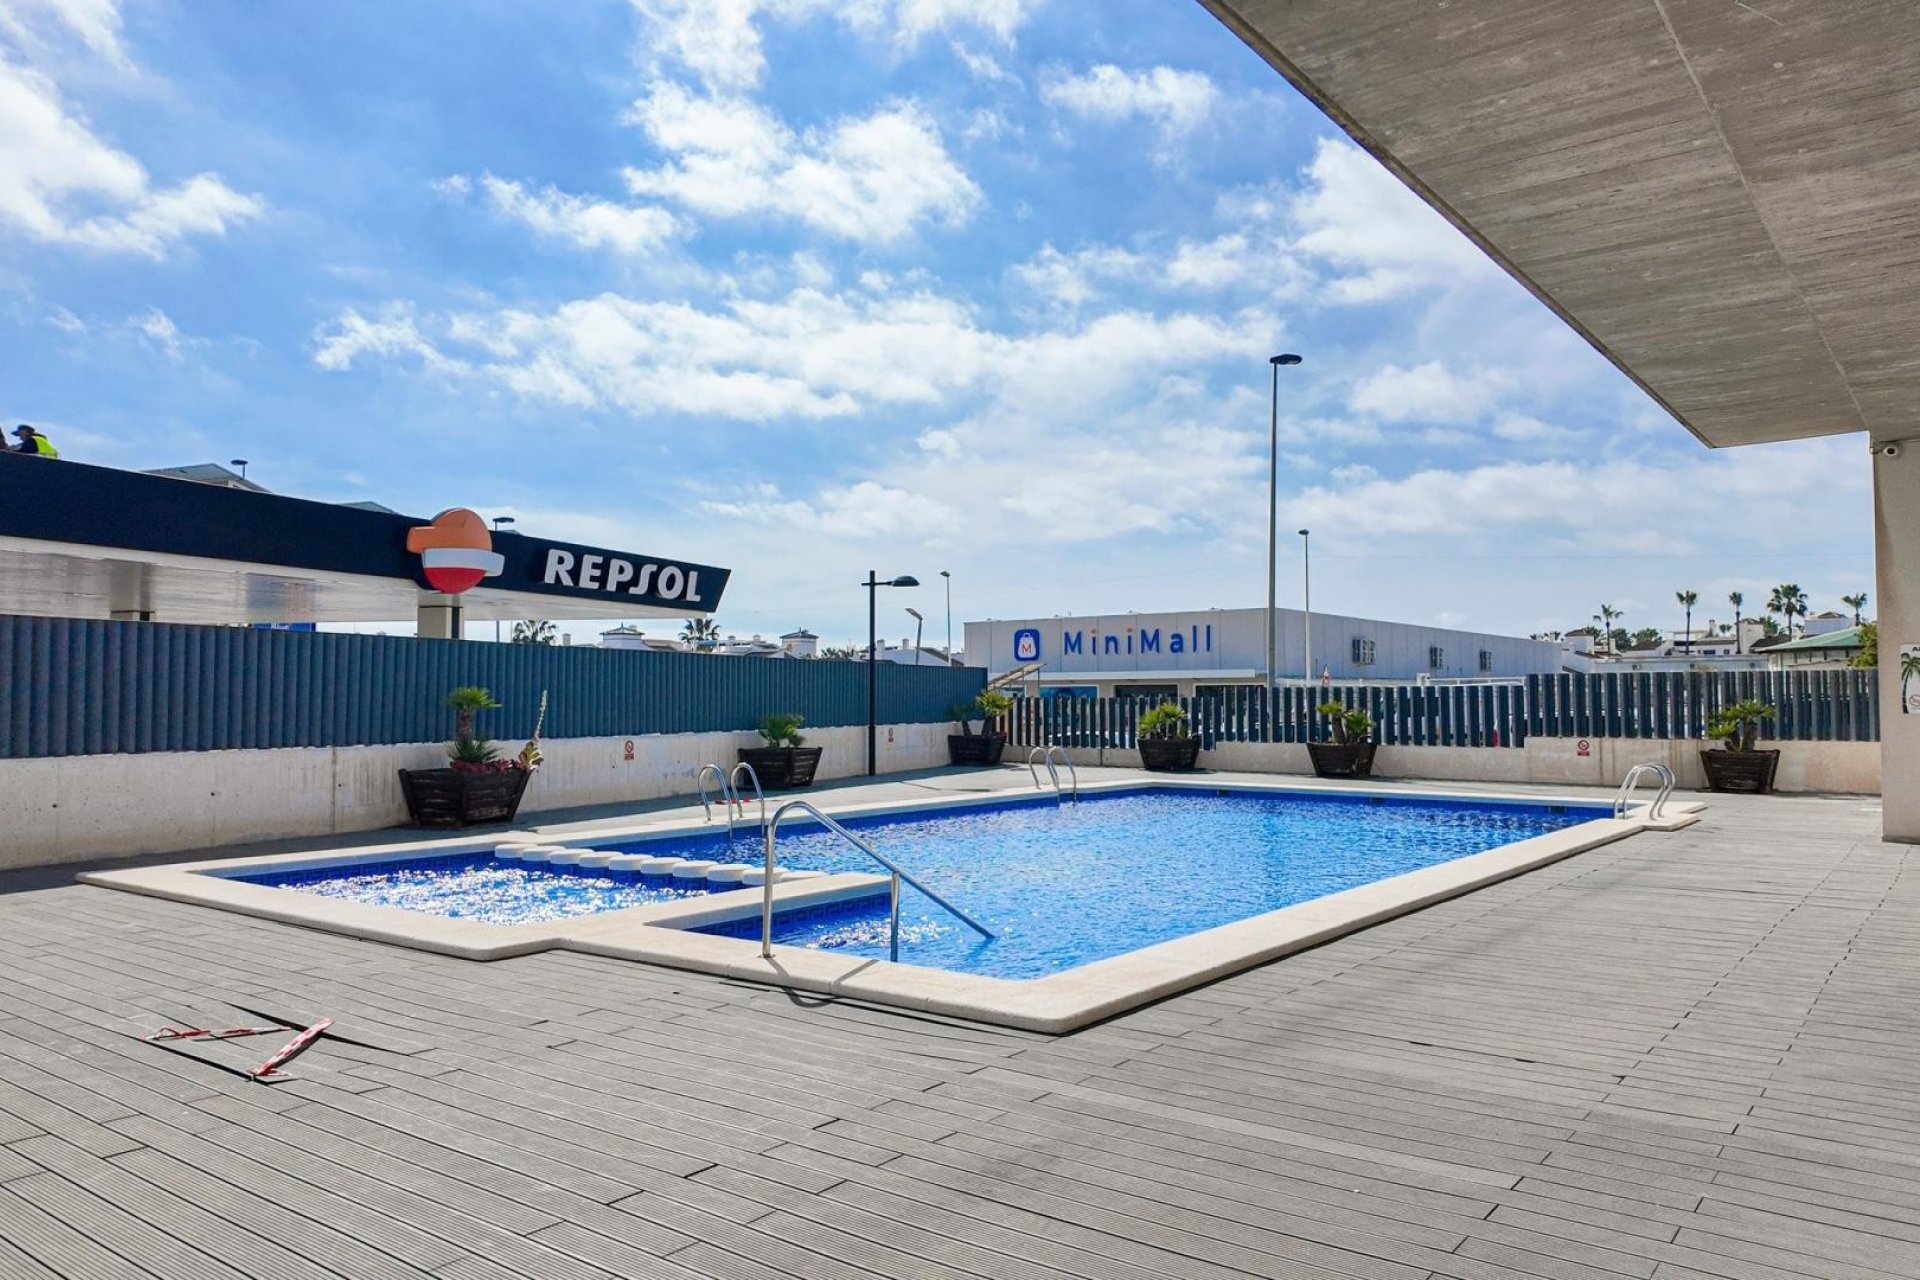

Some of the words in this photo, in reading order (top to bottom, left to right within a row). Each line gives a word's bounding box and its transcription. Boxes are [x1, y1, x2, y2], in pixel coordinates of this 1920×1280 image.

[544, 549, 702, 602] REPSOL
[1022, 643, 1032, 654] M
[1064, 625, 1211, 655] MiniMall
